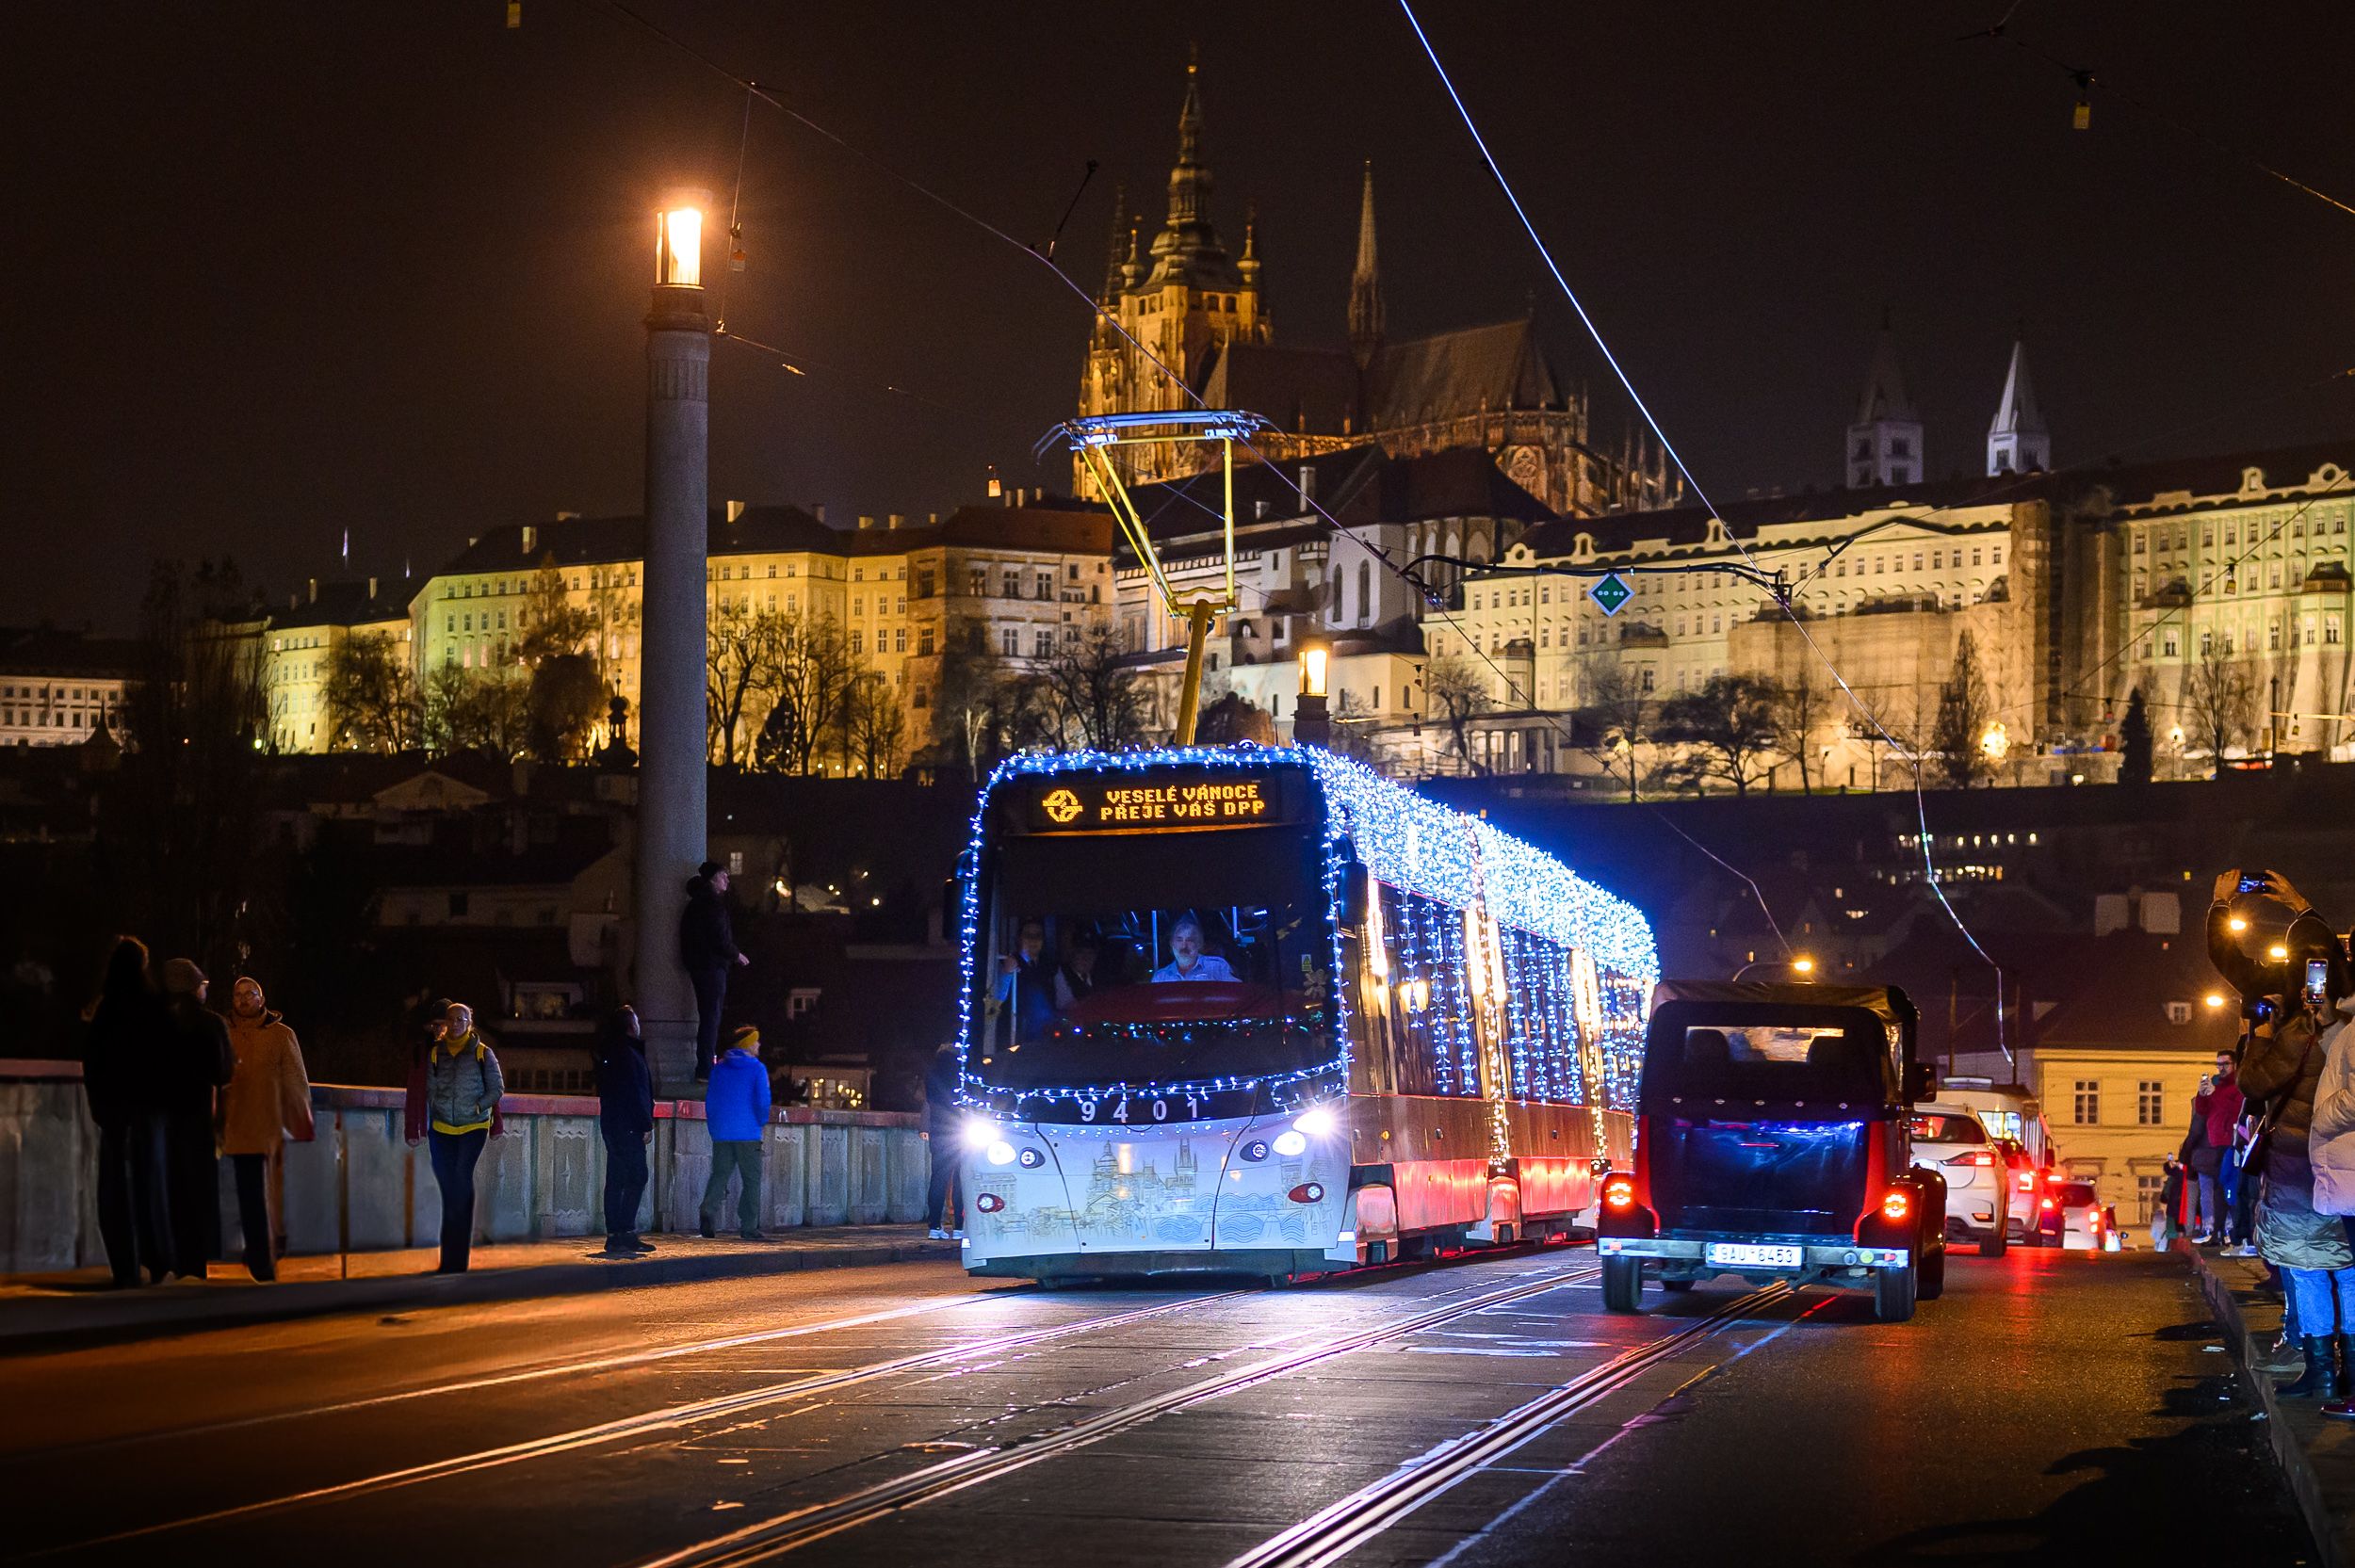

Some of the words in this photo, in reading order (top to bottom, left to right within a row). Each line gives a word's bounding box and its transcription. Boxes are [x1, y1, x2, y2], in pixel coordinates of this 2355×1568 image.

[1106, 784, 1178, 804] VESELÉ
[1182, 784, 1259, 801] VÁNOCE
[1100, 802, 1165, 820] PŘEJE
[1174, 800, 1216, 817] VÁŠ
[1224, 800, 1265, 816] DPP
[1080, 1098, 1198, 1123] 9401
[1758, 1248, 1793, 1263] 6453
